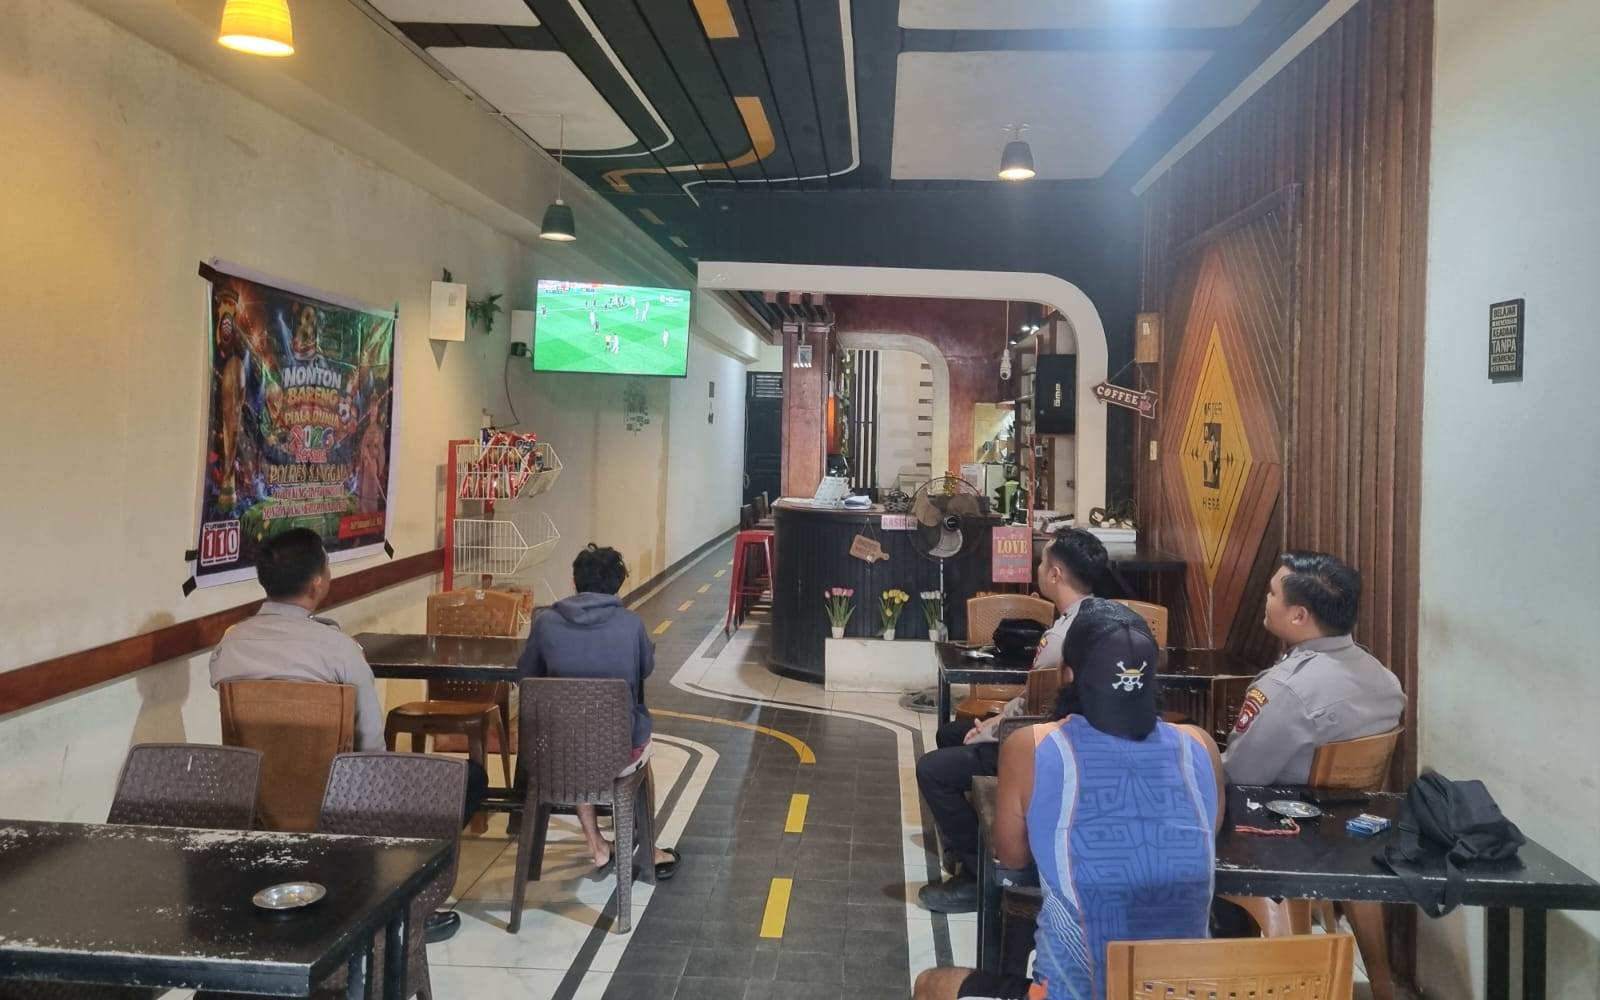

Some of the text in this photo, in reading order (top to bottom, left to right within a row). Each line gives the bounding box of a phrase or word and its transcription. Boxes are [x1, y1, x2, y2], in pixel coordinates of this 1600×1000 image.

[1492, 339, 1516, 353] TANPA
[283, 366, 342, 389] NONTON
[287, 386, 338, 406] BARENG
[1096, 386, 1139, 405] COFFEE
[284, 411, 311, 425] PIALA
[290, 424, 335, 450] 2026
[270, 464, 307, 483] POLRES
[206, 529, 238, 557] 110
[997, 539, 1028, 554] LOVE
